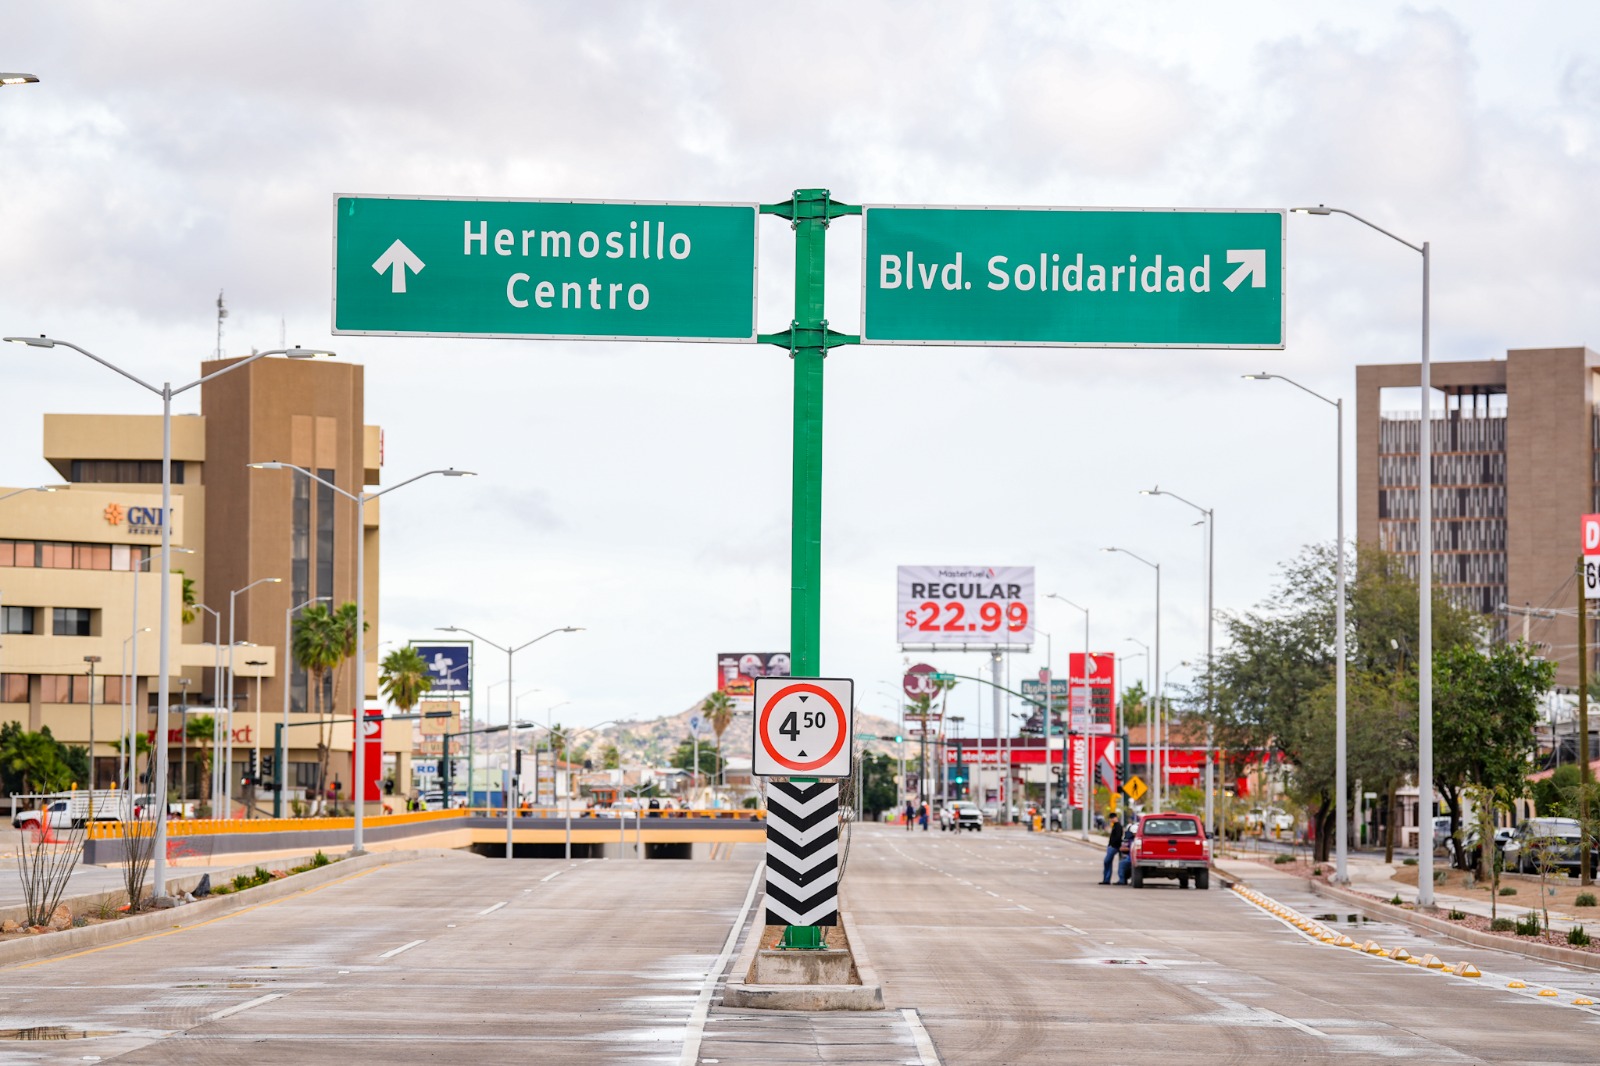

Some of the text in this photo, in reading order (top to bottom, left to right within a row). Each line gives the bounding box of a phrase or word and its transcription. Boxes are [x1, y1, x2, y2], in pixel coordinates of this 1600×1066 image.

[464, 220, 691, 260] Hermosillo
[879, 251, 1211, 293] Blvd. Solidaridad
[506, 272, 650, 311] Centro
[938, 569, 985, 579] Masterfuel
[911, 582, 1021, 599] REGULAR
[905, 601, 1028, 632] $22.99
[1071, 676, 1112, 685] Maserfuel
